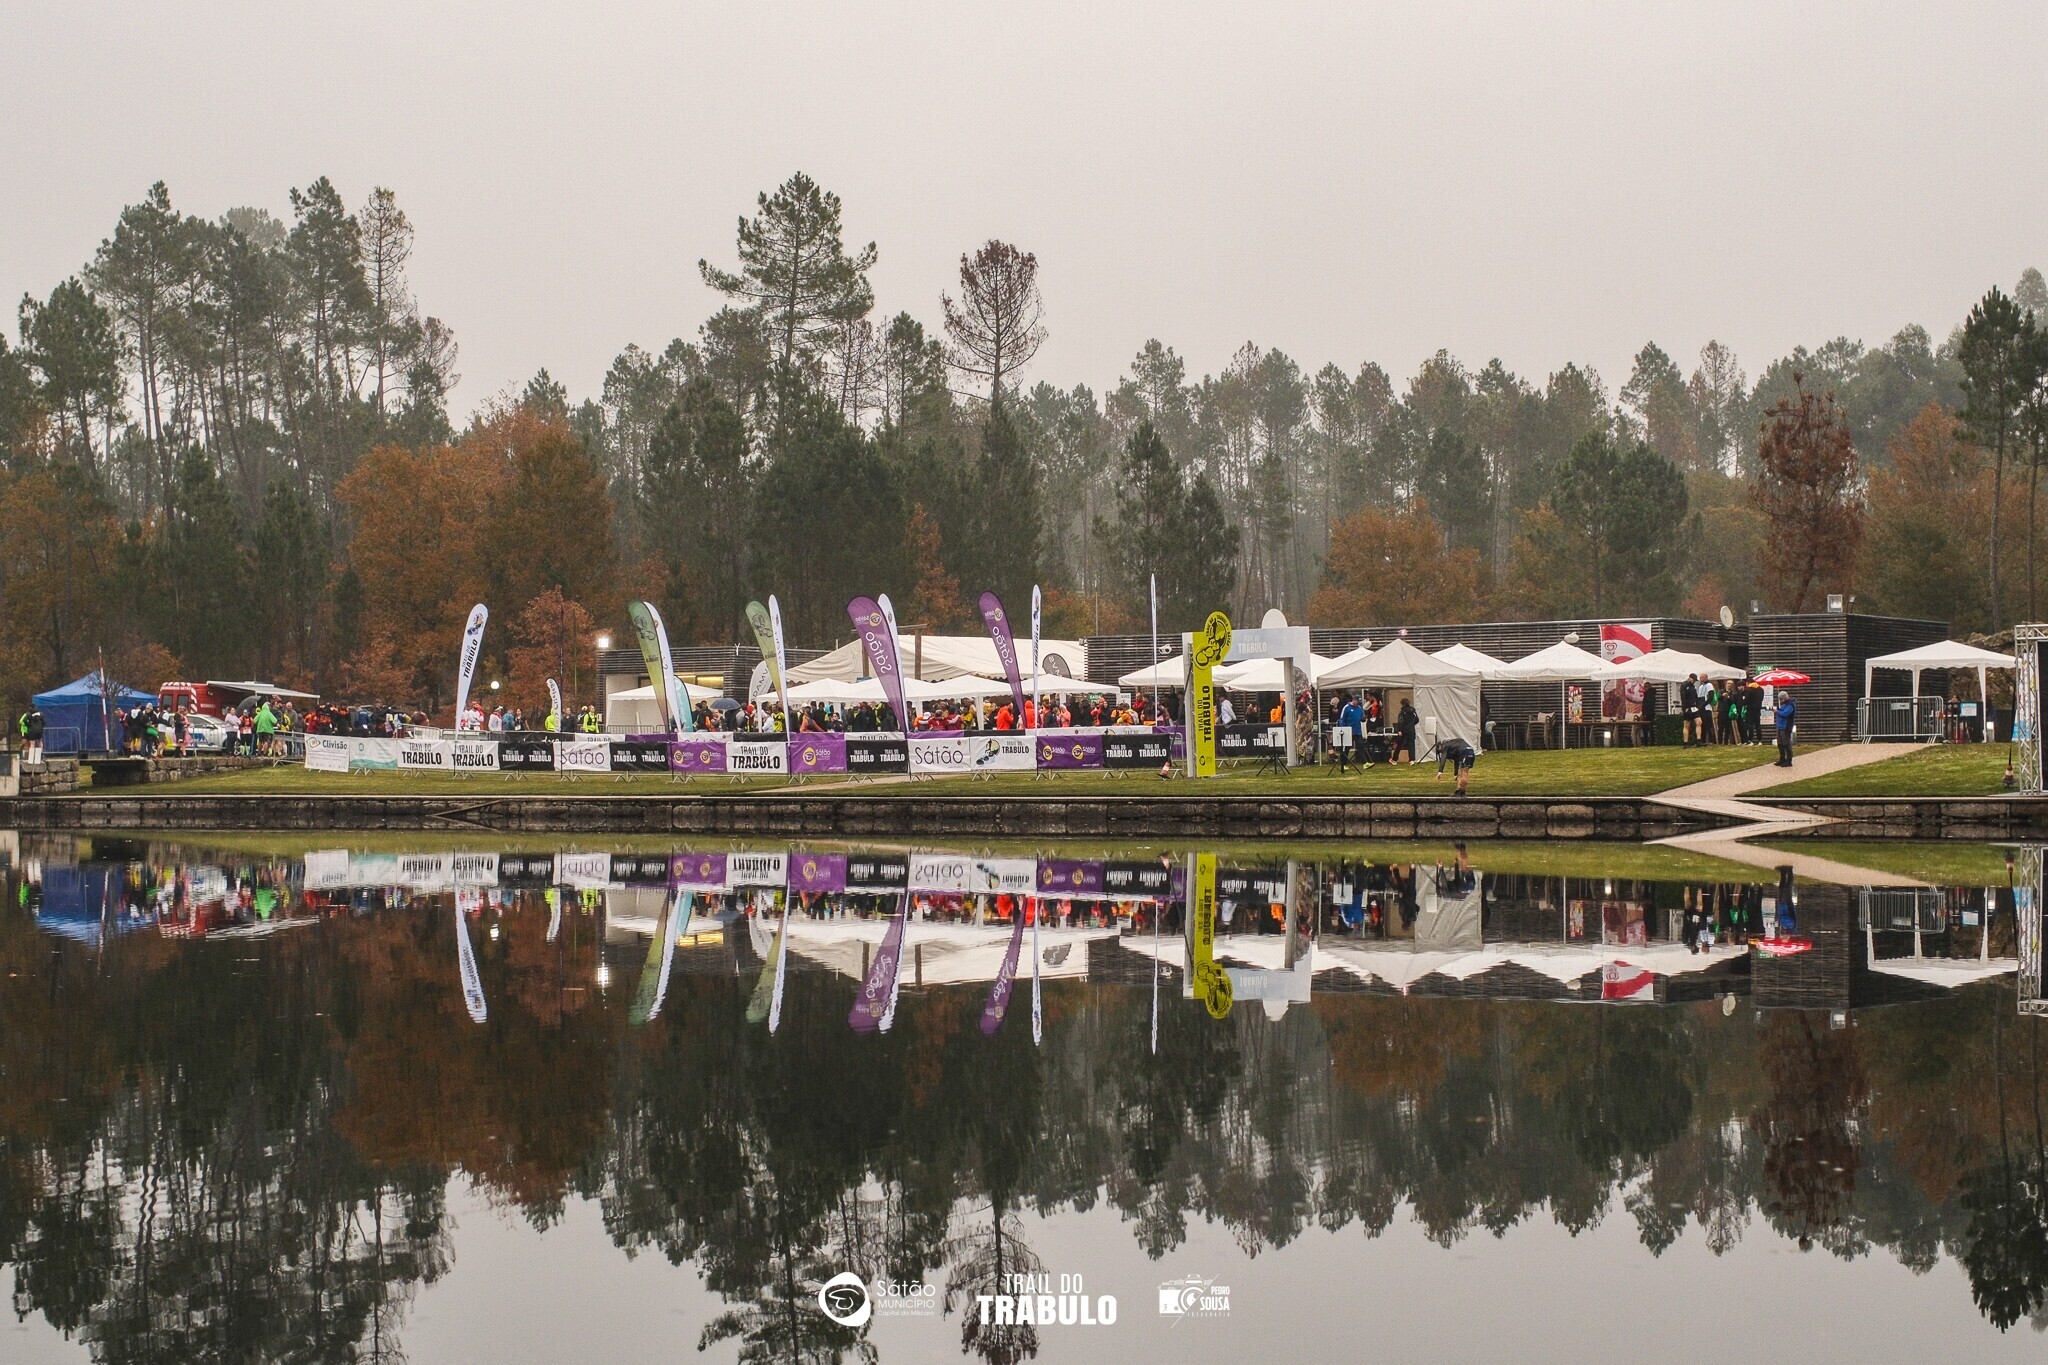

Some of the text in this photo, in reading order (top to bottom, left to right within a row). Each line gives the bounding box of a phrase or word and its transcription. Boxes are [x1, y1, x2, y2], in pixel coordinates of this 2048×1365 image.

[1238, 642, 1267, 654] TRABULO
[1202, 685, 1211, 743] TRABULO
[322, 740, 348, 750] Clivisão
[1221, 739, 1247, 747] TRABULO
[914, 745, 964, 765] Sátão
[1002, 746, 1030, 754] TRABULO
[1105, 749, 1133, 758] TRABULO
[1138, 748, 1167, 758] TRABULO
[402, 751, 442, 765] TRABULO
[452, 753, 494, 767] TRABULO
[560, 749, 605, 765] Sátão
[731, 755, 781, 769] TRABULO
[850, 754, 875, 763] TRABULO
[880, 753, 906, 762] TRABULO
